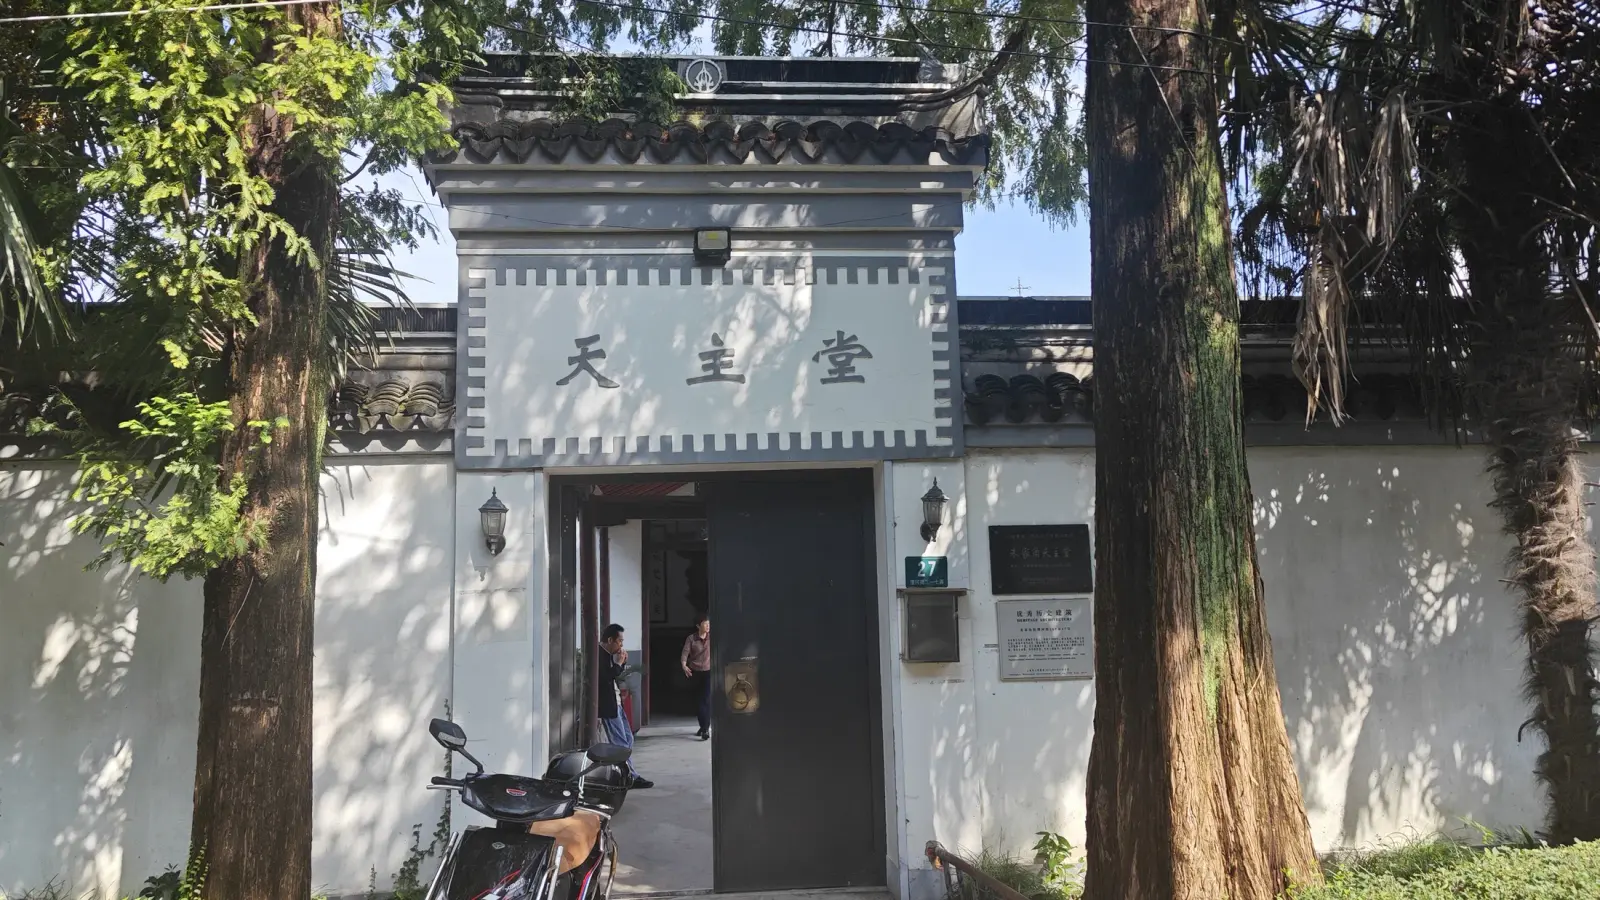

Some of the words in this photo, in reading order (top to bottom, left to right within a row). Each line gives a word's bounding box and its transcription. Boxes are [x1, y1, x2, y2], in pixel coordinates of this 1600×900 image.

[556, 330, 874, 389] 天主堂
[917, 560, 937, 577] 27
